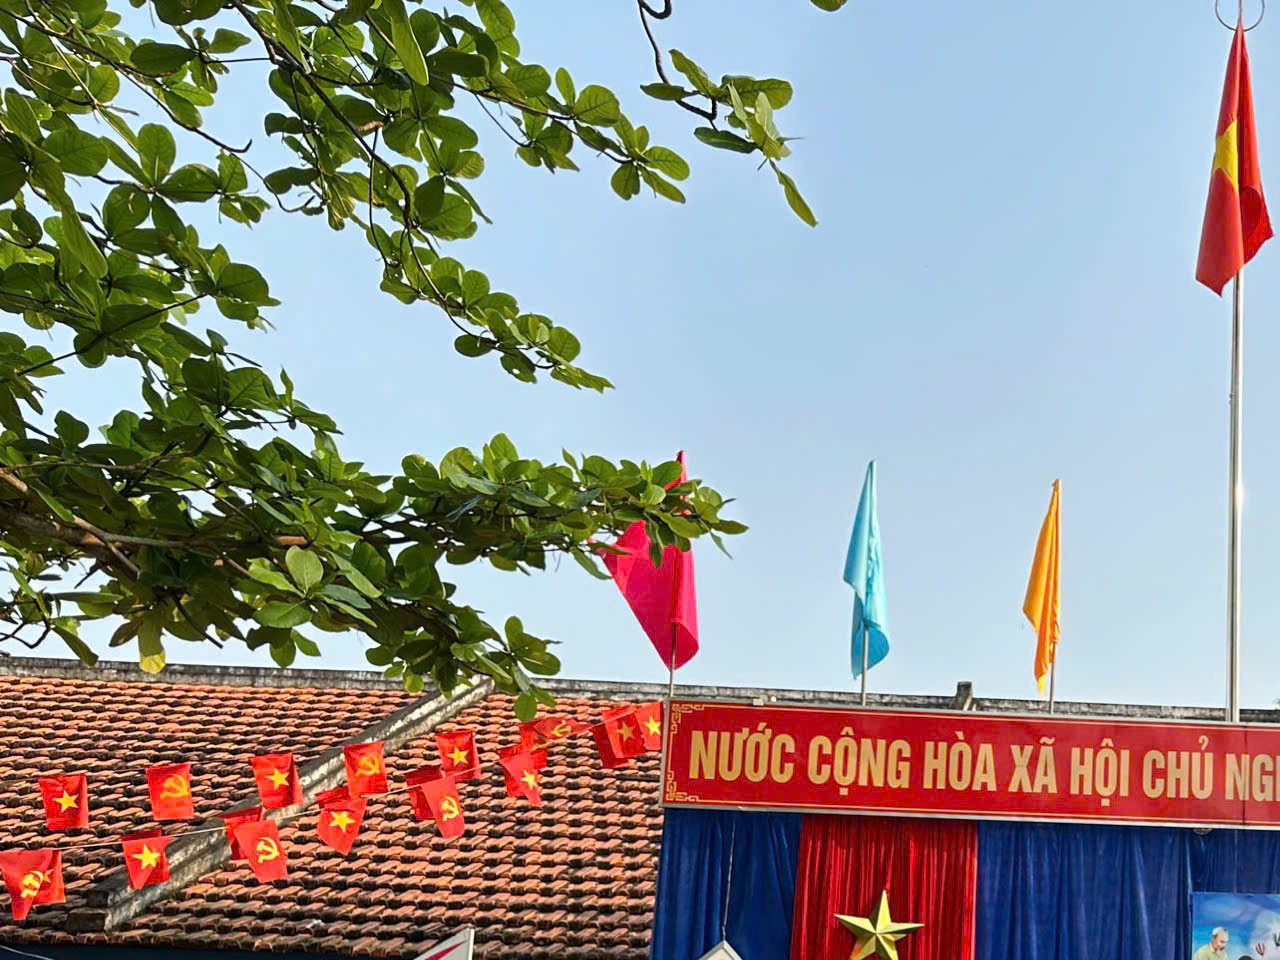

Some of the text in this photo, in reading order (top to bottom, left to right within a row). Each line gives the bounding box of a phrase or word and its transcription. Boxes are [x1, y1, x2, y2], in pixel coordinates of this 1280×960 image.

[689, 722, 795, 783] NƯỚC
[807, 726, 911, 796] CỘNG
[923, 731, 998, 792] HÒA
[1008, 737, 1058, 794] XÃ
[1071, 738, 1129, 807] HỘI
[1142, 735, 1213, 799] CHỦ
